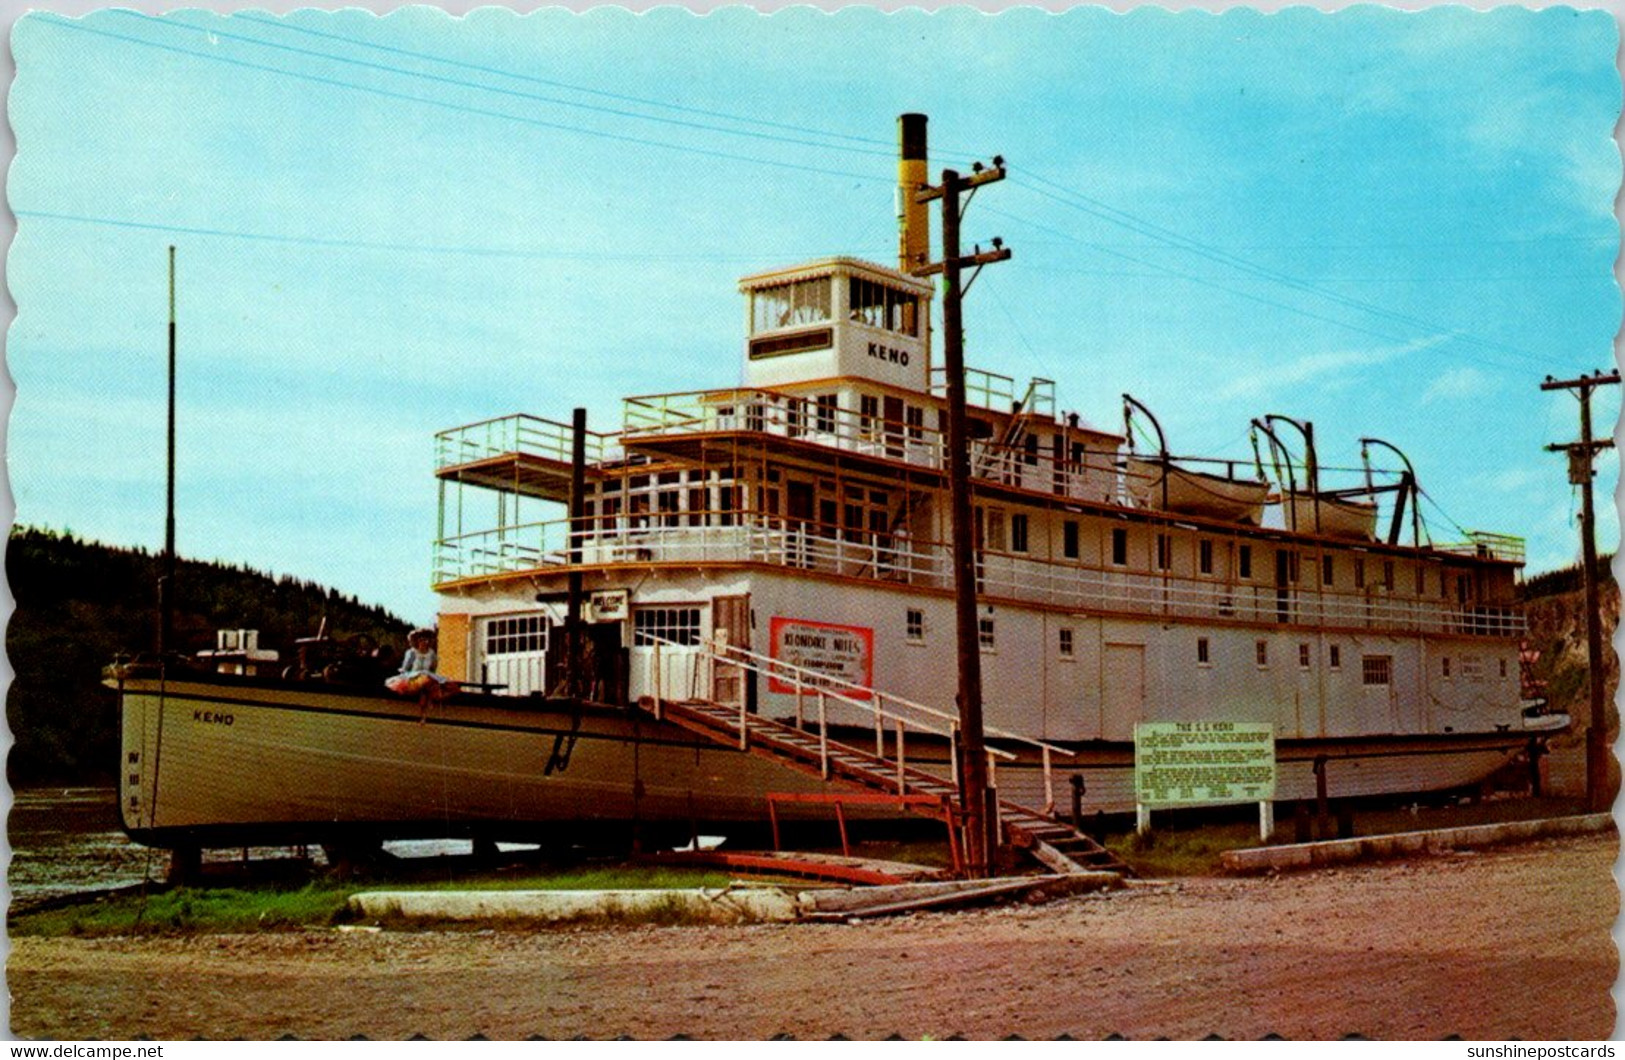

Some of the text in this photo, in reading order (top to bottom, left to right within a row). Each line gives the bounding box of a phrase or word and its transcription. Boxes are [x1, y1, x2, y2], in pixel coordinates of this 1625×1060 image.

[868, 342, 909, 366] KENO
[193, 710, 235, 726] KENO
[1176, 723, 1192, 732] THE
[1212, 722, 1235, 731] KENO
